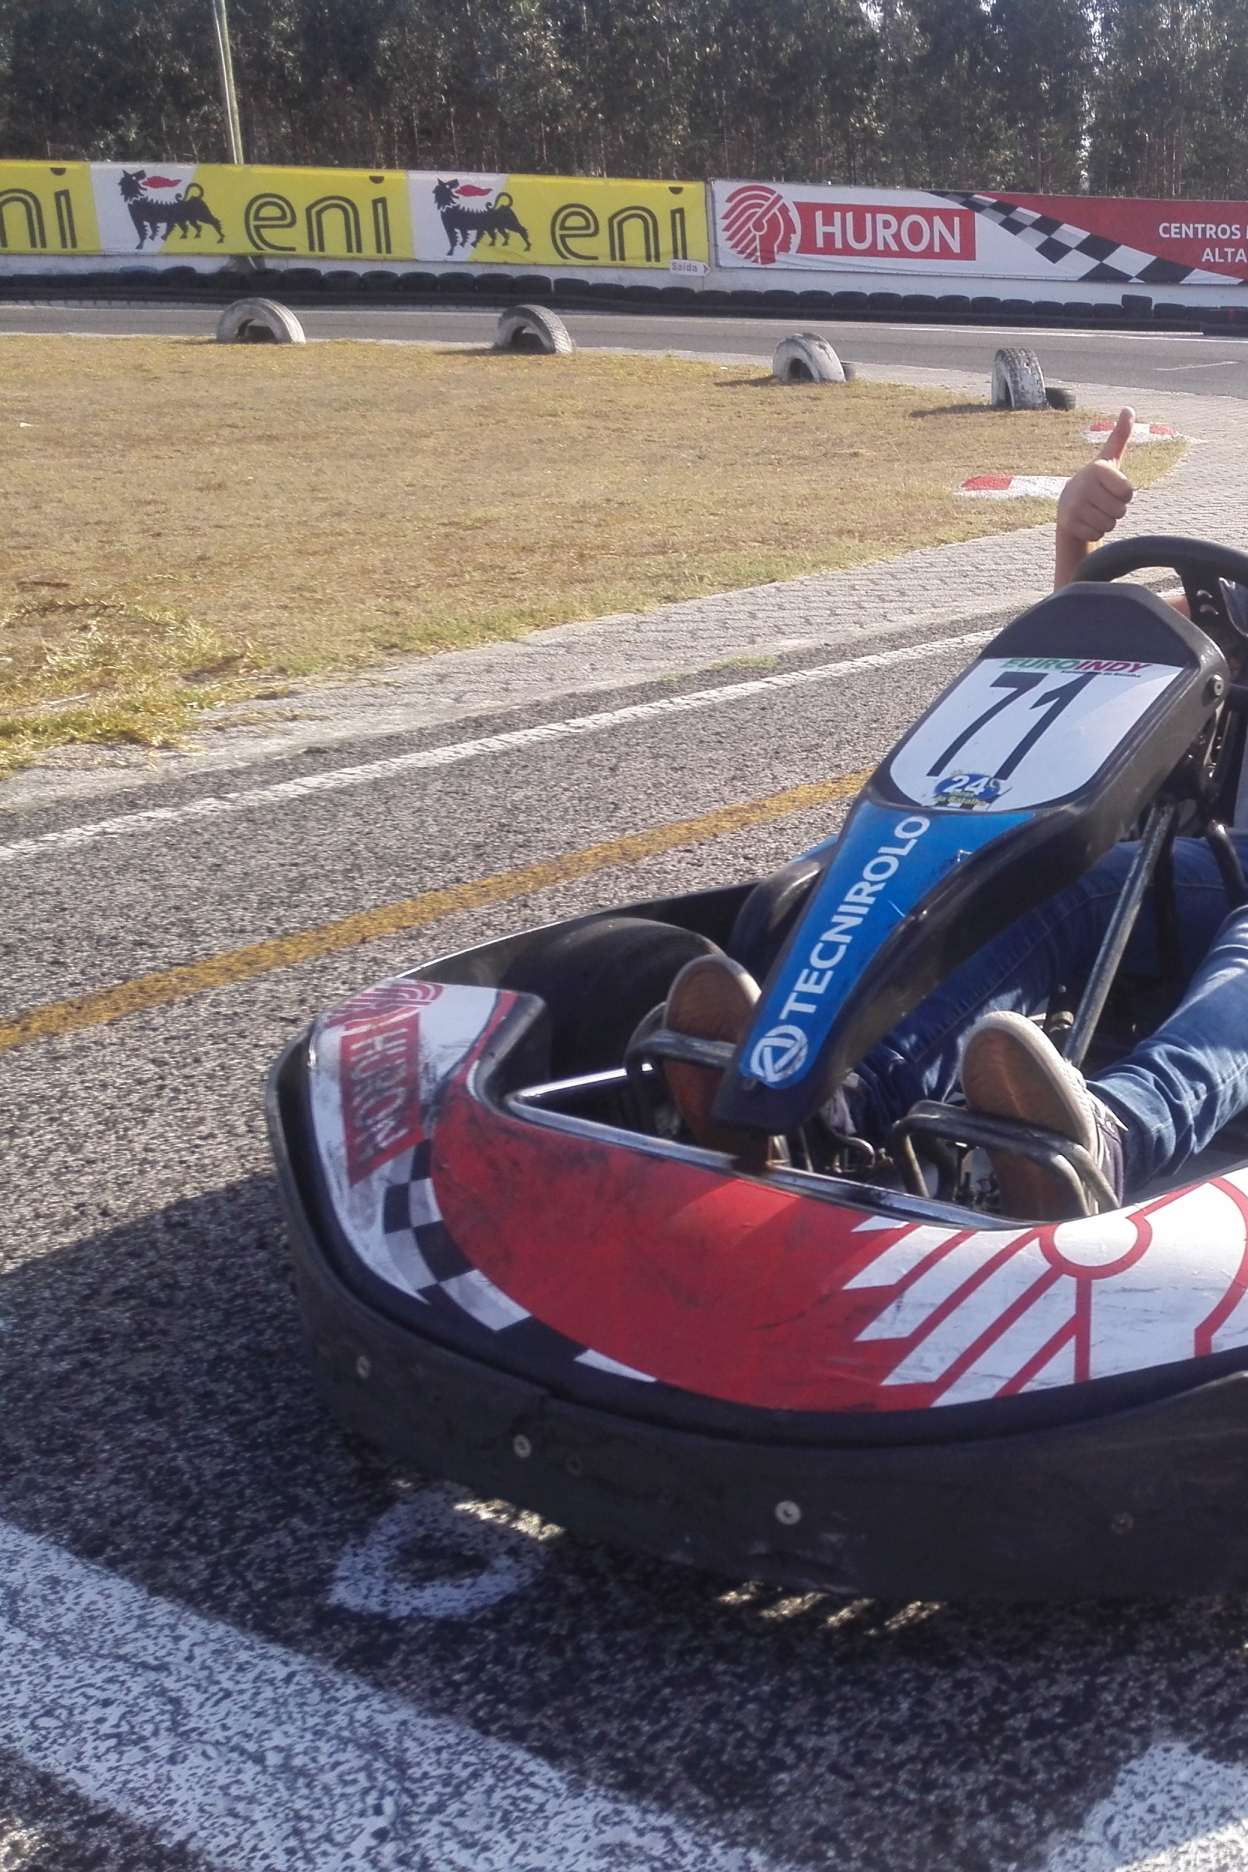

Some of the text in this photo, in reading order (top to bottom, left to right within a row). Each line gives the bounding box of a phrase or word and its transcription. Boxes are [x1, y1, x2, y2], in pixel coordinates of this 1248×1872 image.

[0, 167, 77, 248] ni
[245, 175, 391, 254] eni
[551, 186, 687, 261] eni
[815, 210, 961, 253] HURON
[1158, 223, 1241, 239] CENTROS
[1201, 247, 1248, 264] ALTA
[1000, 657, 1153, 673] EUROINDY
[926, 670, 1099, 781] 71
[779, 815, 931, 1020] TECNIROLO
[350, 1028, 410, 1162] HURON
